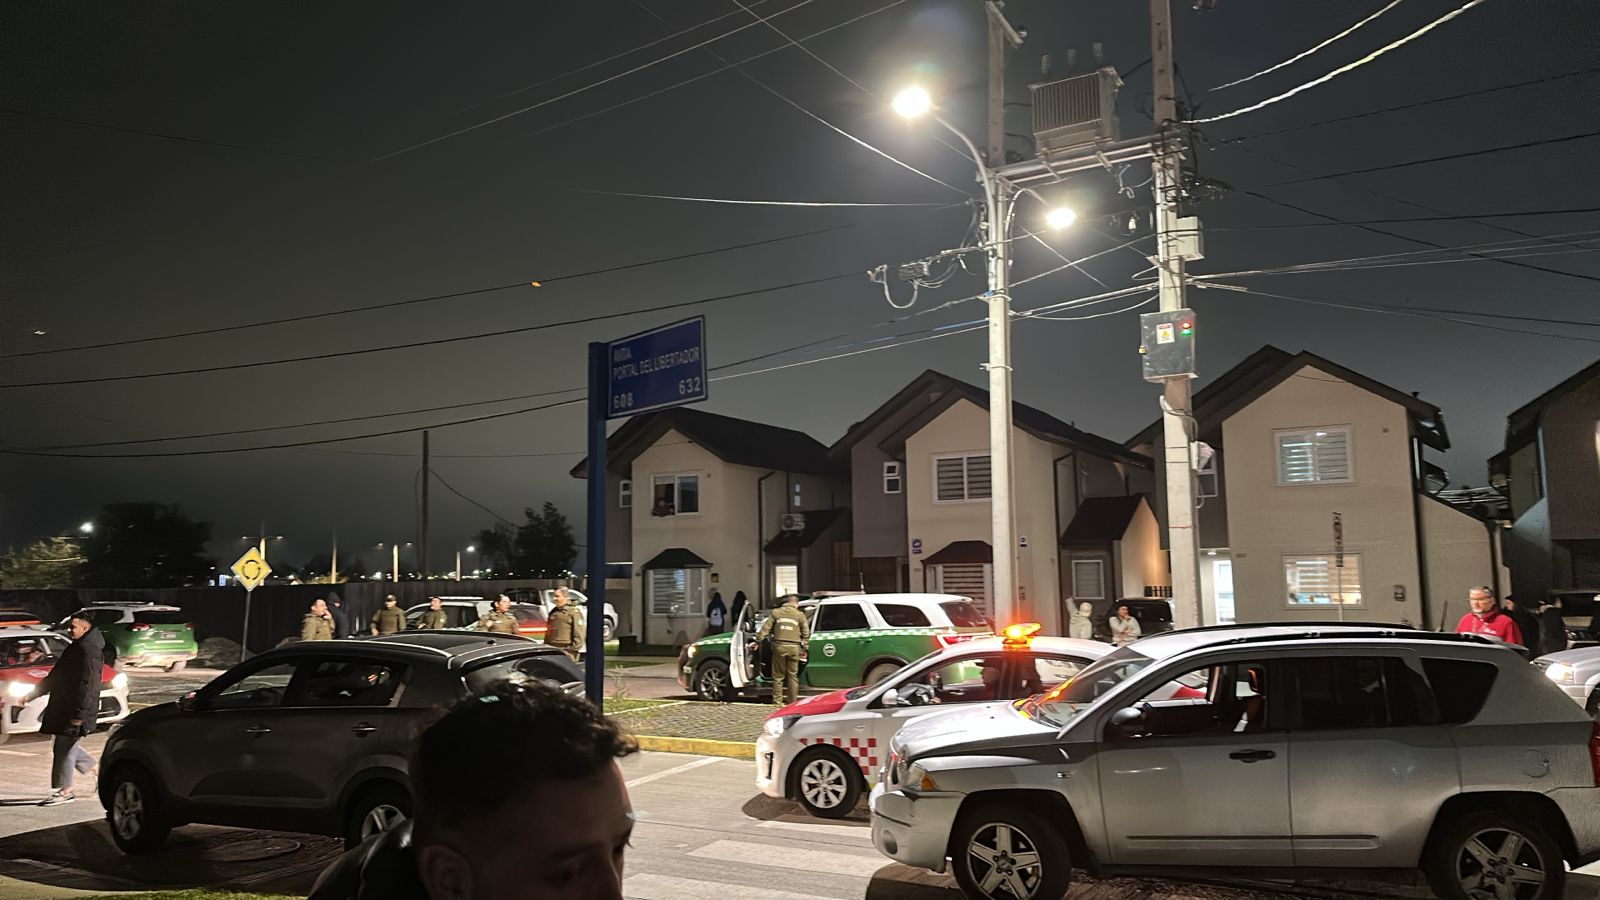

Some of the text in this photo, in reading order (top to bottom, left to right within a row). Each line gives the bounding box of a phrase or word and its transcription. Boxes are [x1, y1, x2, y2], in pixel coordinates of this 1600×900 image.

[613, 362, 639, 380] PORTAL
[654, 347, 700, 371] LIBERTADOR
[679, 376, 701, 395] 632
